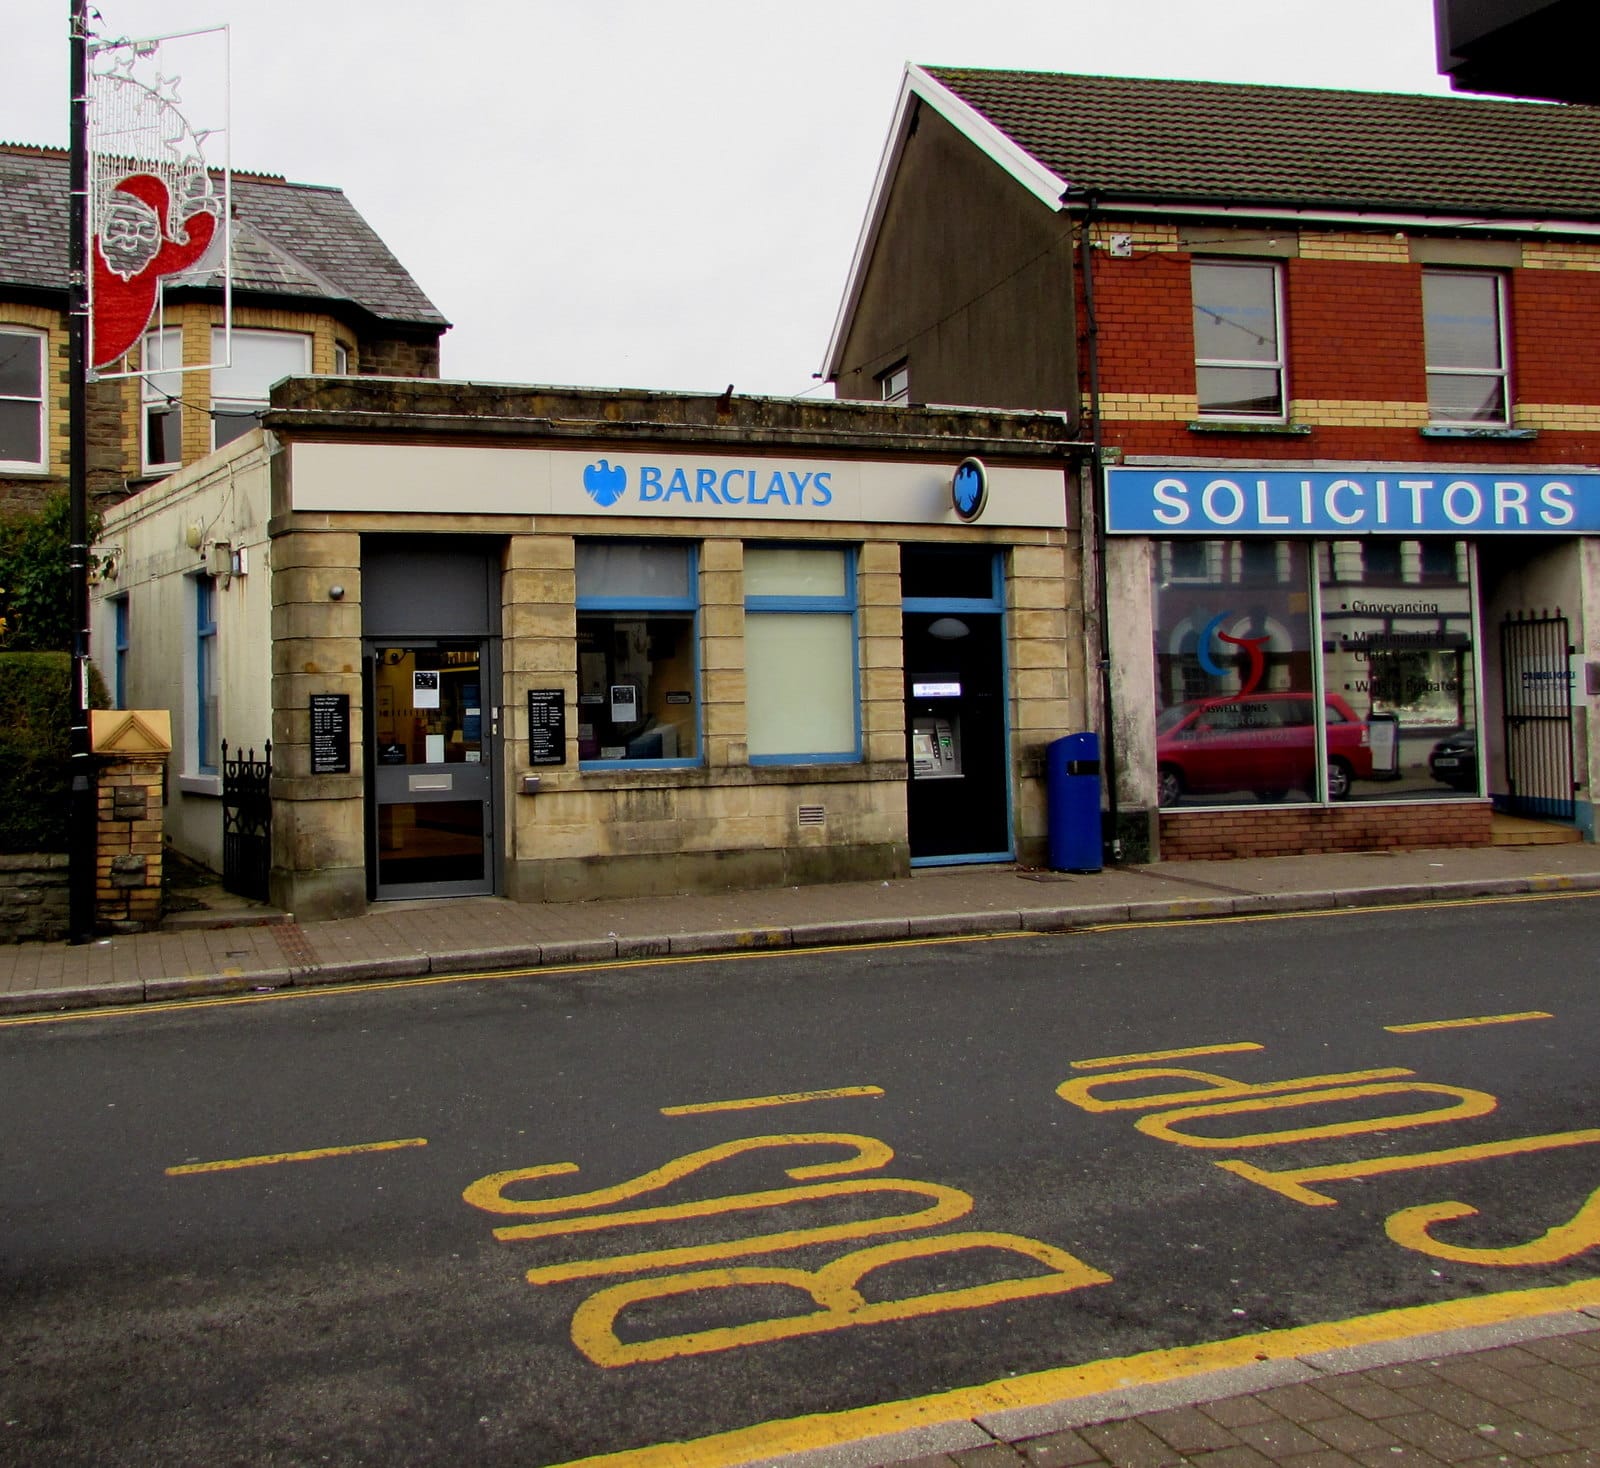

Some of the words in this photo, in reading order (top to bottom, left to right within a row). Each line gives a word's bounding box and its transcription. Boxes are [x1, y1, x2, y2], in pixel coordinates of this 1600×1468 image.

[639, 466, 833, 507] BARCLAYS
[1152, 479, 1575, 525] SOLICITORS
[1352, 600, 1439, 615] Conveyancing
[462, 1132, 1113, 1368] BUS
